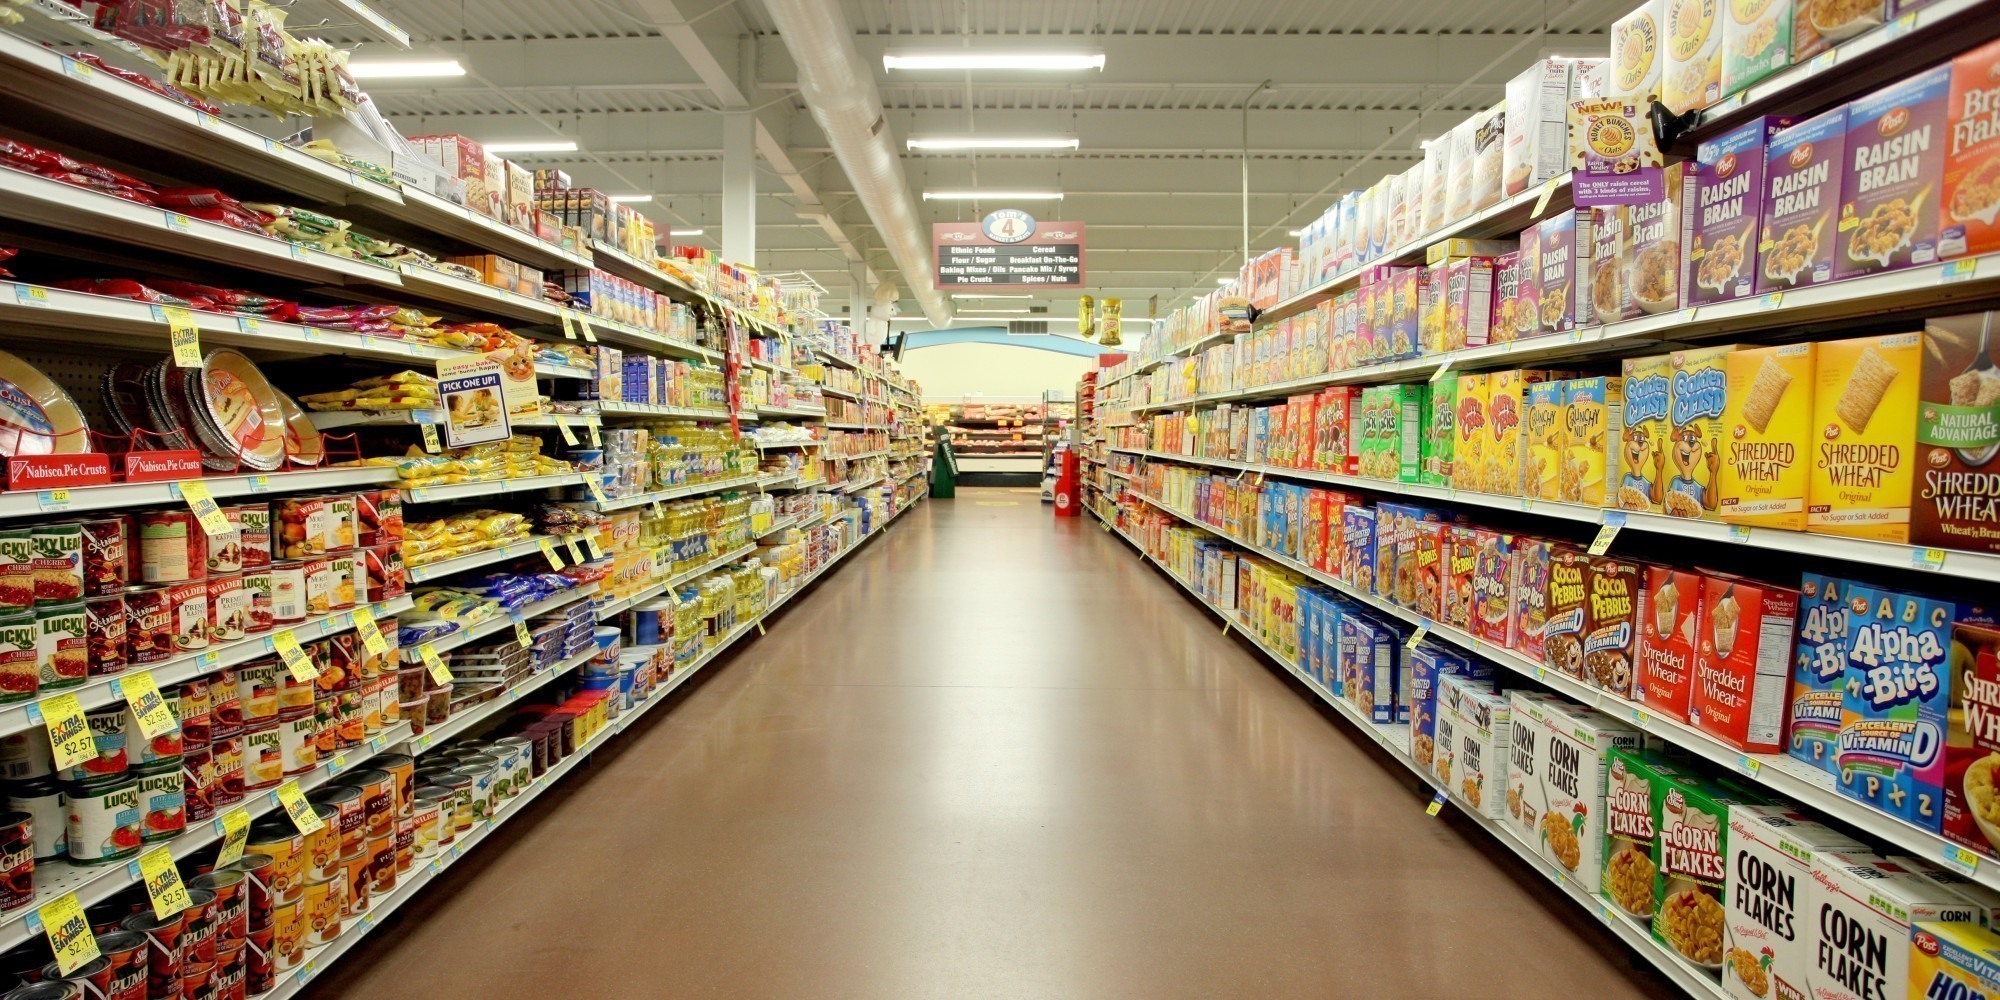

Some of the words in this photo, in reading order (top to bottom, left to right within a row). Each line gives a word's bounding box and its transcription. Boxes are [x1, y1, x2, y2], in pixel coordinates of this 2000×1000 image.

[1570, 100, 1585, 110] TRY
[1577, 101, 1622, 114] NEW!
[1590, 121, 1605, 142] HONEY
[1606, 118, 1632, 141] BUNCHES
[1604, 146, 1622, 154] Oats
[1854, 124, 1931, 171] RAISIN
[1771, 160, 1829, 198] RAISIN
[1858, 156, 1920, 193] BRAN
[1701, 170, 1750, 208] RAISIN
[1628, 199, 1672, 226] Raisin
[1703, 197, 1743, 226] BRAN
[1774, 187, 1819, 218] BRAN
[991, 211, 1028, 221] Tom's
[1001, 219, 1015, 236] 4
[1592, 216, 1622, 243] Raisin
[1633, 221, 1665, 246] Bran
[1009, 256, 1042, 264] Breakfast
[1542, 244, 1568, 268] RAISIN
[1595, 240, 1617, 261] Bran
[940, 266, 965, 274] Baking
[1009, 266, 1039, 274] Pancake
[1058, 265, 1078, 274] Syrup
[1544, 263, 1565, 282] BRAN
[31, 289, 45, 298] 7.13
[173, 327, 194, 340] EXTRA
[174, 333, 197, 348] SAVINGS!
[180, 348, 198, 358] $3.90
[443, 381, 461, 391] PICK
[463, 379, 480, 388] ONE
[482, 376, 496, 386] UP!
[1532, 383, 1555, 393] NEW!
[1569, 380, 1598, 391] NEW!
[1625, 373, 1669, 400] Golden
[1673, 366, 1726, 396] Golden
[1566, 404, 1600, 432] CRUNCHY
[1941, 412, 1993, 428] NATURAL
[1574, 425, 1587, 437] NUT
[1931, 424, 1998, 441] ADVANTAGE
[167, 460, 178, 471] Pie
[178, 459, 200, 470] Crusts
[1728, 442, 1794, 465] SHREDDED
[1818, 443, 1899, 469] SHREDDED
[64, 463, 78, 476] Pie
[80, 463, 107, 475] Crusts
[1737, 461, 1791, 481] WHEAT
[1829, 466, 1895, 488] WHEAT
[54, 492, 66, 500] 2.27
[1746, 485, 1772, 496] Original
[1839, 491, 1872, 504] Original
[1738, 505, 1752, 513] Sugar
[1830, 514, 1846, 522] Sugar
[1927, 550, 1941, 558] 4.19
[1553, 563, 1582, 585] COCOA
[1594, 574, 1627, 597] COCOA
[1550, 582, 1585, 608] PEBBLES
[1590, 594, 1631, 622] PEBBLES
[44, 617, 82, 634] LUCKY
[1642, 640, 1686, 671] Shredded
[1850, 623, 1944, 668] Alpha
[1647, 658, 1678, 685] Wheat
[1697, 658, 1745, 693] Shredded
[131, 691, 157, 711] EXTRA
[1649, 684, 1673, 700] Original
[1702, 678, 1736, 708] Wheat
[136, 694, 162, 720] SAVINGS!
[145, 711, 168, 726] $2.55
[1705, 705, 1731, 724] Original
[51, 714, 80, 738] EXTRA
[53, 719, 86, 747] SAVINGS!
[1854, 721, 1915, 733] EXCELLENT
[1861, 730, 1886, 738] SOURCE
[64, 737, 92, 756] $2.57
[1464, 735, 1481, 760] CORN
[1512, 720, 1535, 756] CORN
[1842, 734, 1913, 755] VITAMIN
[1911, 722, 1939, 764] D
[1463, 753, 1481, 772] FLAKES
[1511, 744, 1534, 776] FLAKES
[1549, 737, 1580, 777] CORN
[138, 774, 177, 793] LUCKY
[1548, 762, 1579, 799] FLAKES
[1615, 786, 1649, 815] CORN
[1606, 796, 1654, 840] FLAKES
[1672, 822, 1718, 854] CORN
[1659, 831, 1725, 880] FLAKES
[1958, 851, 1974, 864] 2.89
[148, 868, 174, 892] EXTRA
[151, 873, 179, 900] SAVINGS!
[1737, 850, 1795, 912] CORN
[1812, 869, 1840, 893] Kellogg's
[162, 888, 186, 907] $2.57
[1736, 883, 1795, 942] FLAKES
[1940, 910, 1971, 922] CORN
[51, 915, 81, 946] EXTRA
[55, 920, 87, 954] SAVINGS!
[1820, 902, 1887, 977] CORN
[69, 934, 94, 958] $2.17
[1915, 935, 1938, 951] Post
[1818, 938, 1887, 1000] FLAKES
